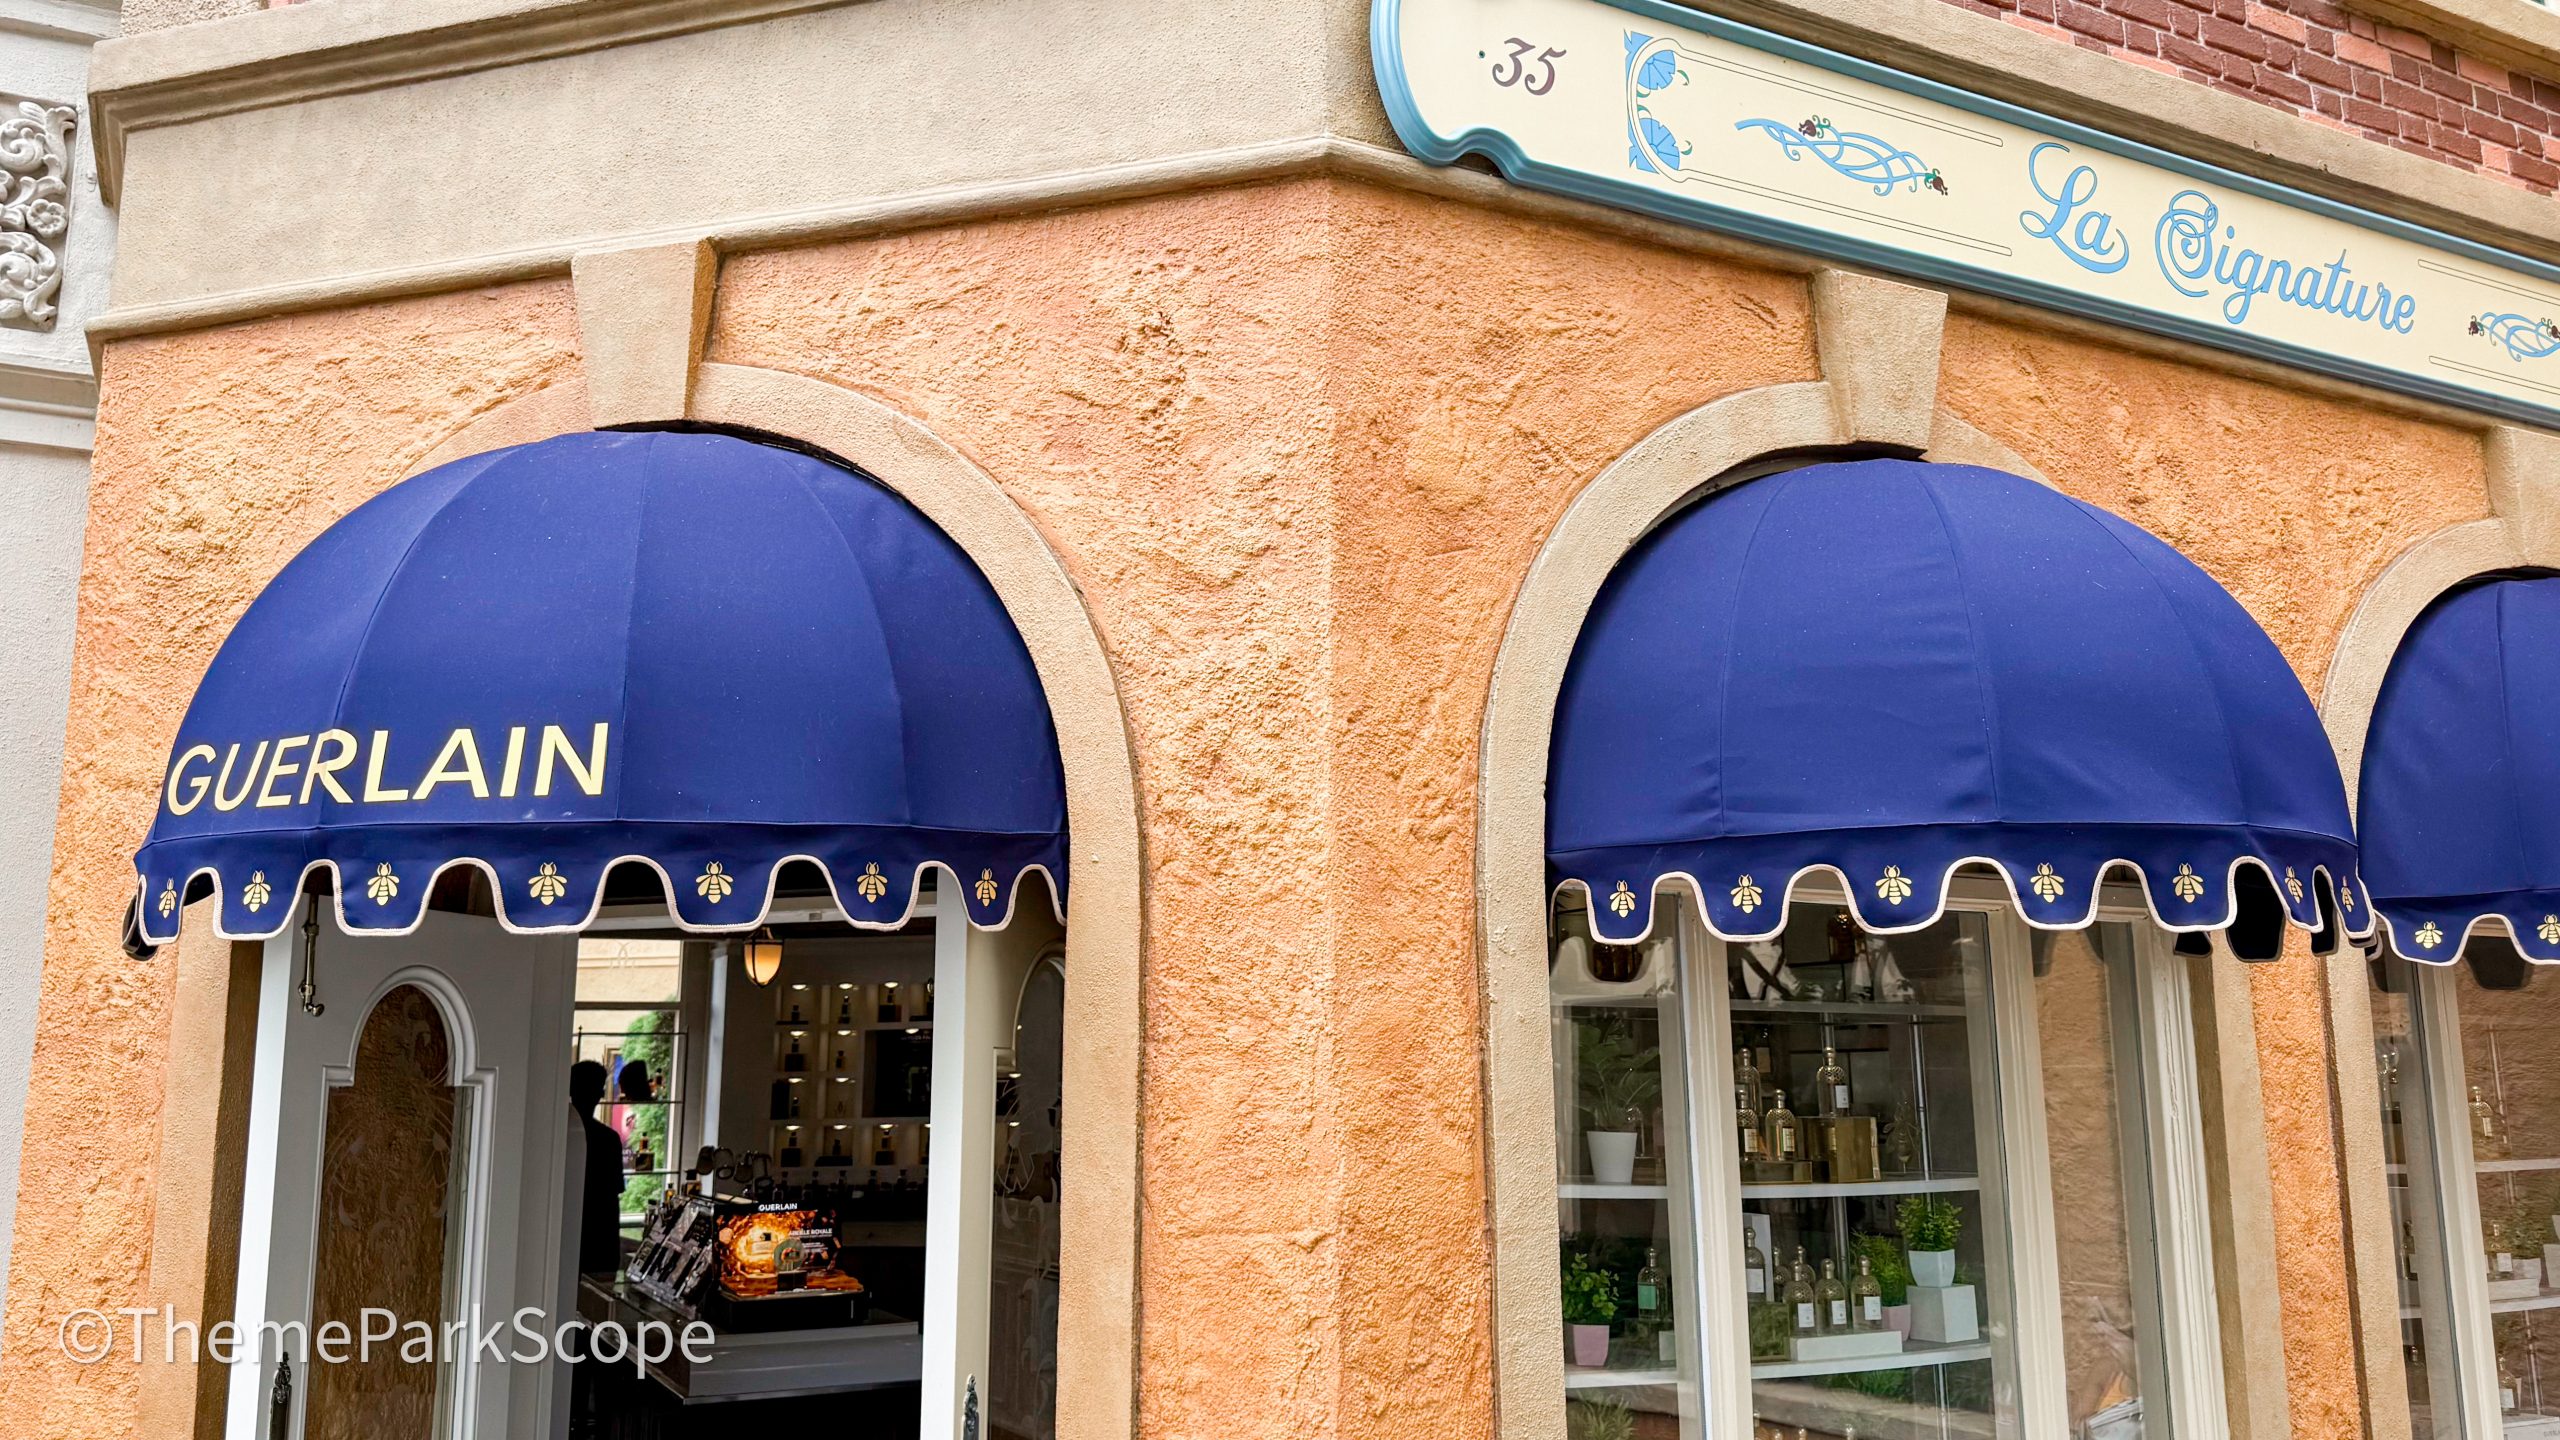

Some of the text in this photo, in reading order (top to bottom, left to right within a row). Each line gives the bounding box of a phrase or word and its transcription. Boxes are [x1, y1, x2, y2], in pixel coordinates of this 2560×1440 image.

[1491, 37, 1567, 96] 35
[2019, 141, 2416, 335] La Signature
[166, 722, 609, 817] GUERLAIN
[758, 1202, 798, 1212] GUERLAIN
